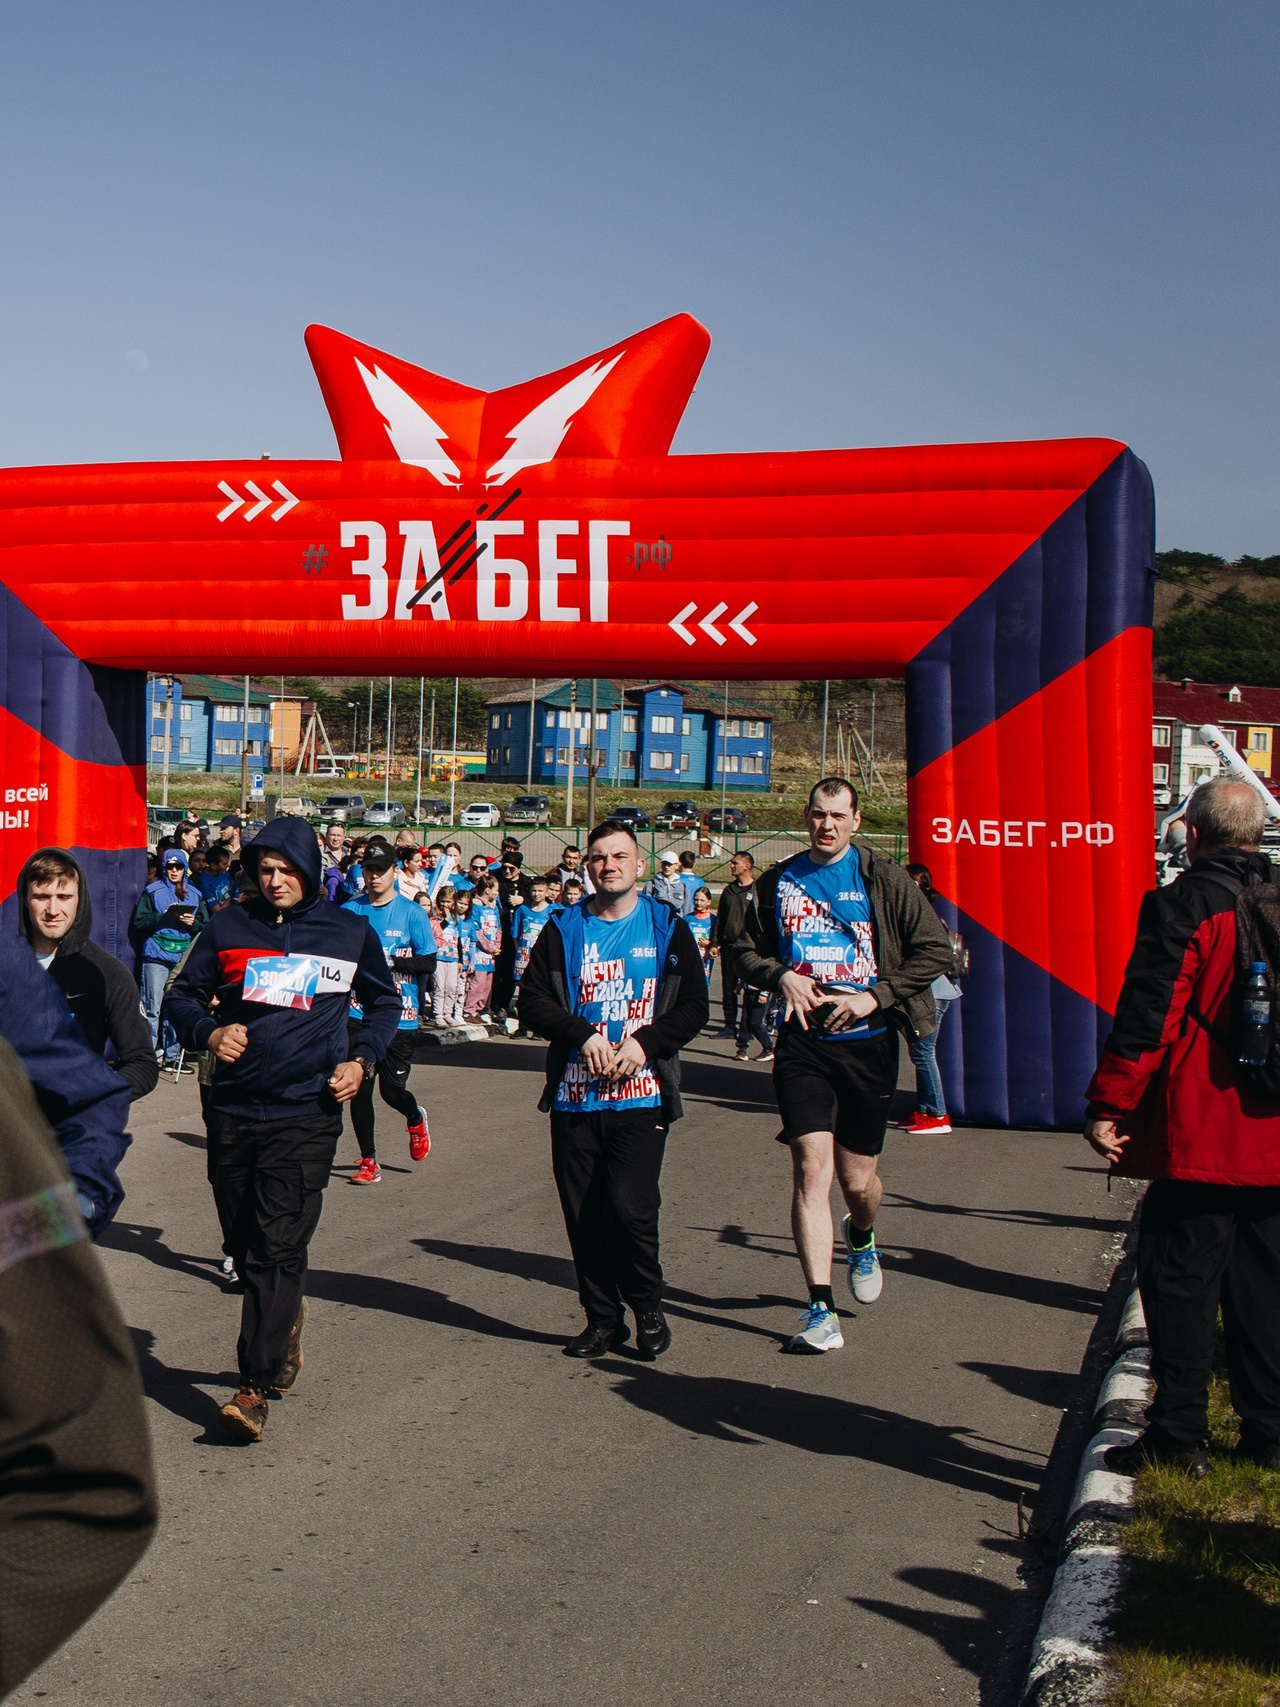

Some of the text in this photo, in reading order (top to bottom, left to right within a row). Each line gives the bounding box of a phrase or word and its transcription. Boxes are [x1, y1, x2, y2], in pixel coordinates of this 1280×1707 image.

[1216, 750, 1232, 766] ПСБ
[254, 774, 263, 787] P
[5, 783, 49, 803] всей
[931, 817, 1114, 847] ЗАБЕГ.РФ
[805, 945, 844, 961] 30050
[320, 966, 341, 982] ILA
[581, 958, 625, 985] МЕЧТА
